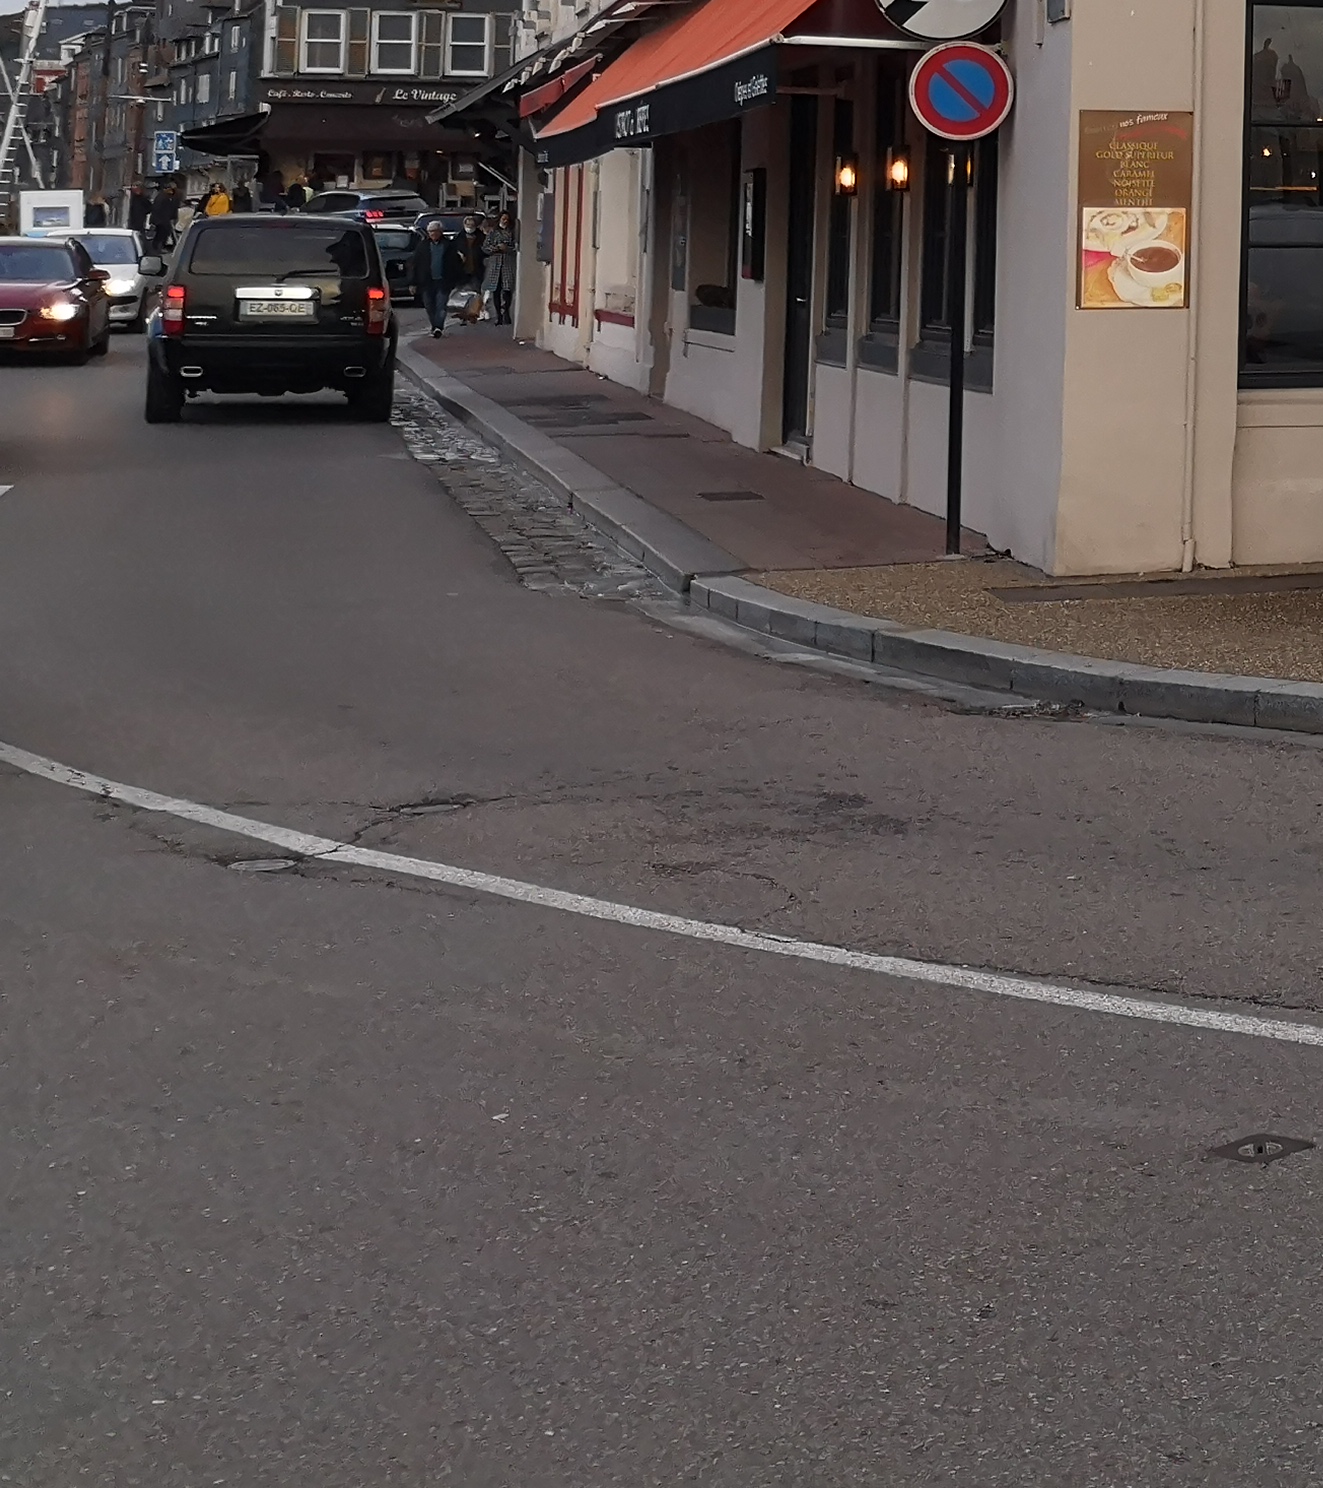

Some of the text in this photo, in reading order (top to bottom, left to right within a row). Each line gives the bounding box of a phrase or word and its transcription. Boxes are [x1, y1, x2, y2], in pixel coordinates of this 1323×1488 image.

[392, 88, 457, 103] Le Vintage
[1119, 118, 1135, 128] nos
[1095, 150, 1123, 159] GOLD
[1120, 160, 1149, 169] BLANC
